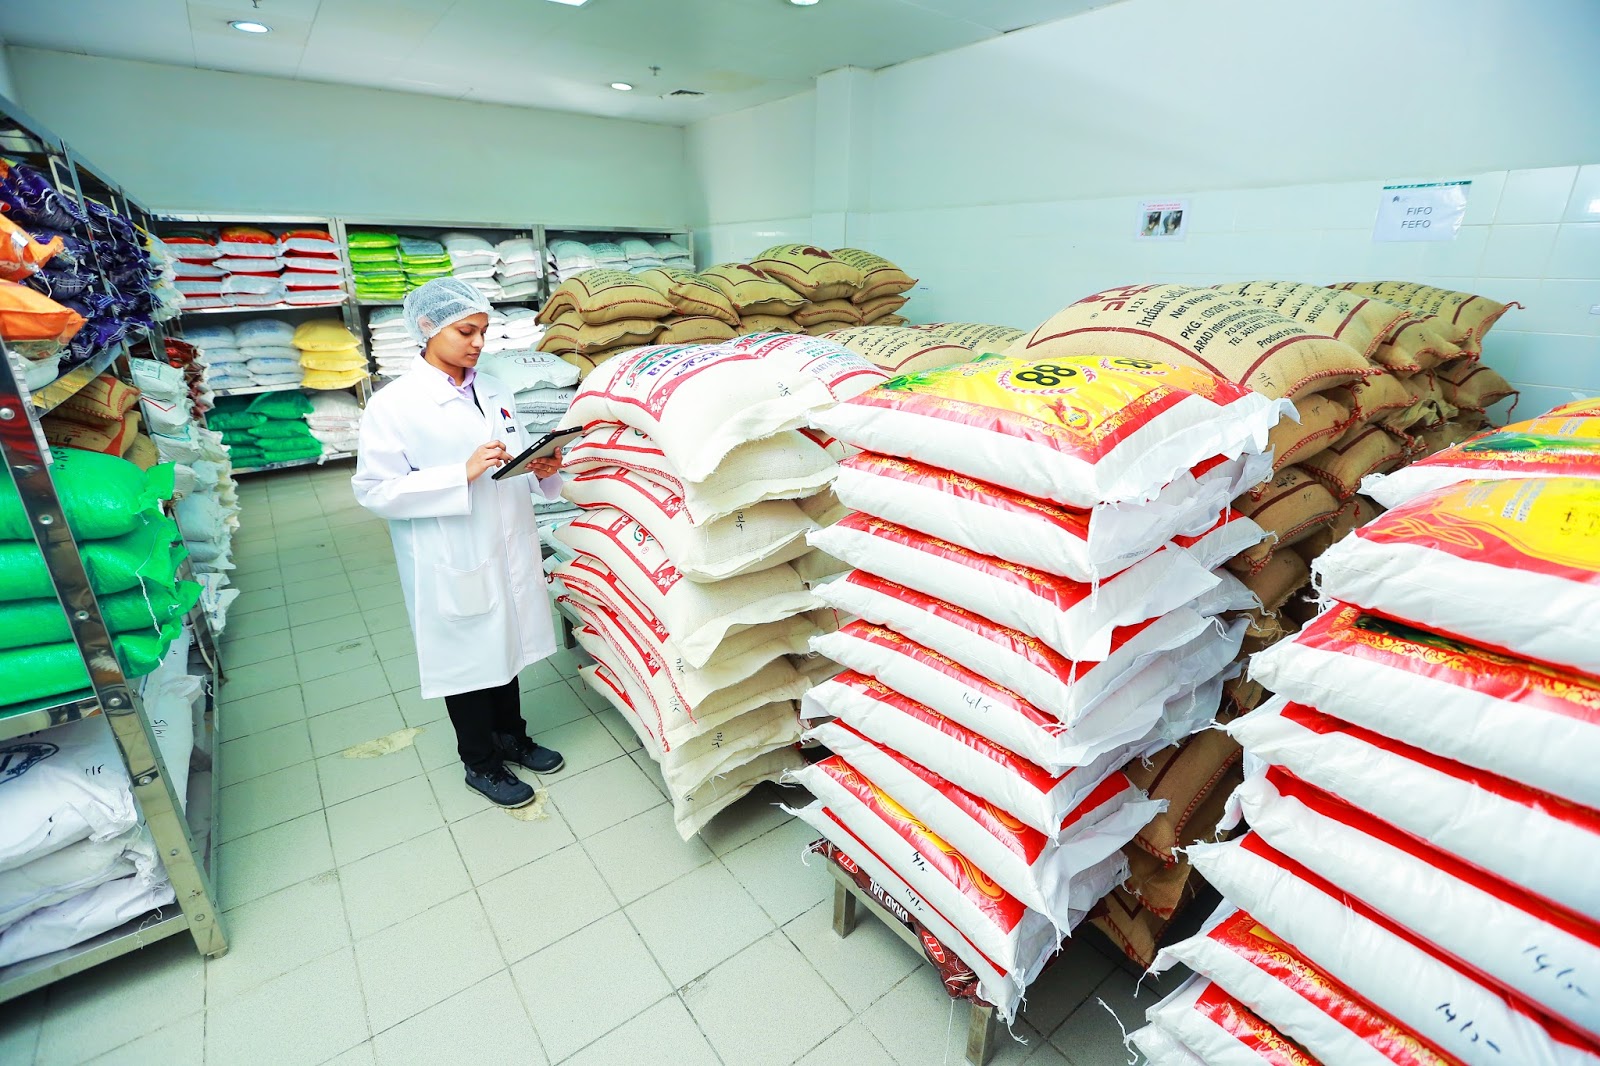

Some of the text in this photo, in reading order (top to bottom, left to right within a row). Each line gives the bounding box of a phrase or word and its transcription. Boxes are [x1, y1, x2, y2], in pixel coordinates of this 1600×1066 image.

[1406, 206, 1433, 216] FIFO
[1401, 219, 1432, 229] FEFO
[1128, 298, 1147, 313] 1121
[1136, 300, 1170, 328] Indian
[1169, 304, 1191, 319] Net
[1193, 331, 1214, 354] ARAD
[1257, 330, 1285, 348] Product
[1015, 364, 1077, 387] 88
[869, 878, 909, 922] URAD DAL
[923, 934, 943, 960] 777
